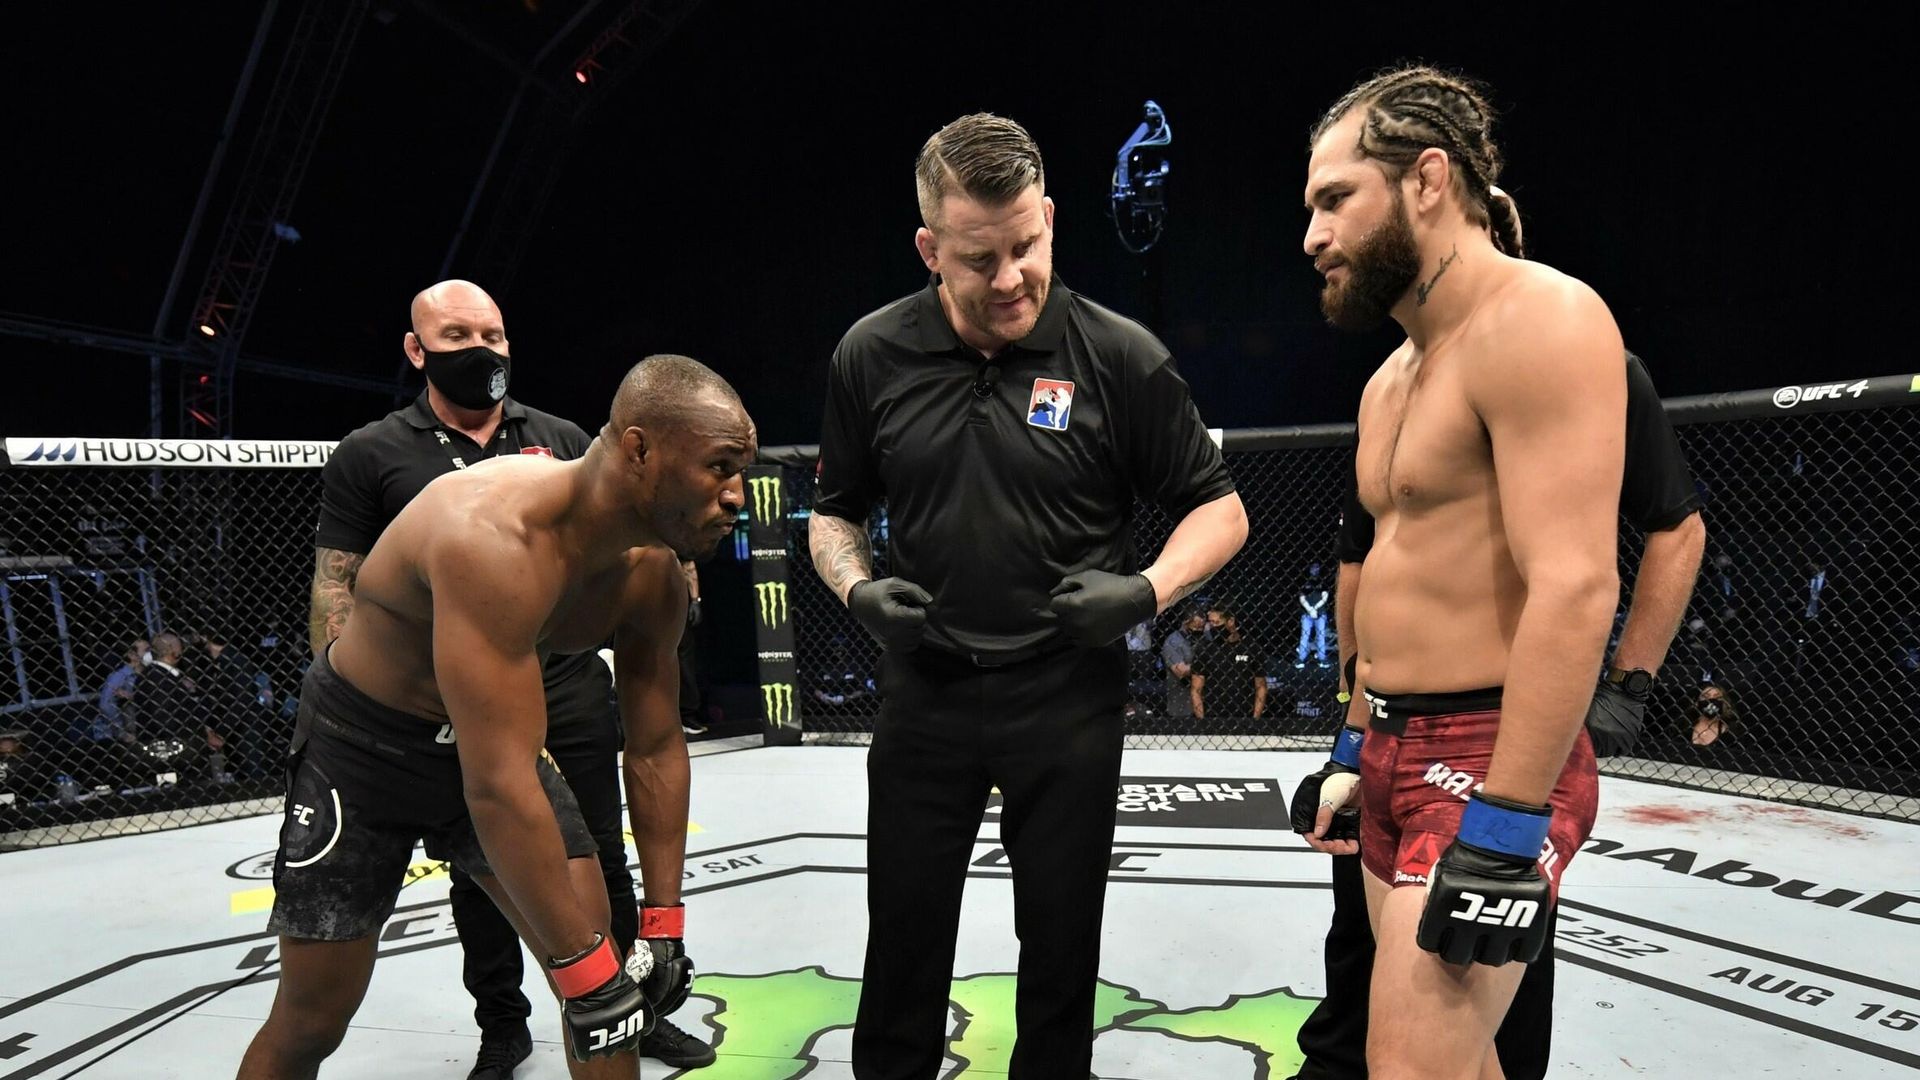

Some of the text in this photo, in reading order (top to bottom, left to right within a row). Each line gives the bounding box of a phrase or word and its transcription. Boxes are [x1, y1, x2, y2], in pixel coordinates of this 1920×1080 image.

[1801, 379, 1869, 401] UFC 4
[83, 441, 334, 463] HUDSON SHIPPI
[452, 457, 468, 471] UF
[1363, 688, 1389, 719] FC
[1117, 782, 1271, 794] RTABLE
[1117, 791, 1245, 802] OTEIN
[293, 804, 315, 826] FC
[1116, 801, 1177, 812] CK
[702, 853, 763, 873] SAT
[1450, 891, 1540, 928] UFC
[1556, 926, 1670, 957] 252
[1708, 966, 1920, 1032] AUG 15
[588, 1008, 645, 1051] UFC
